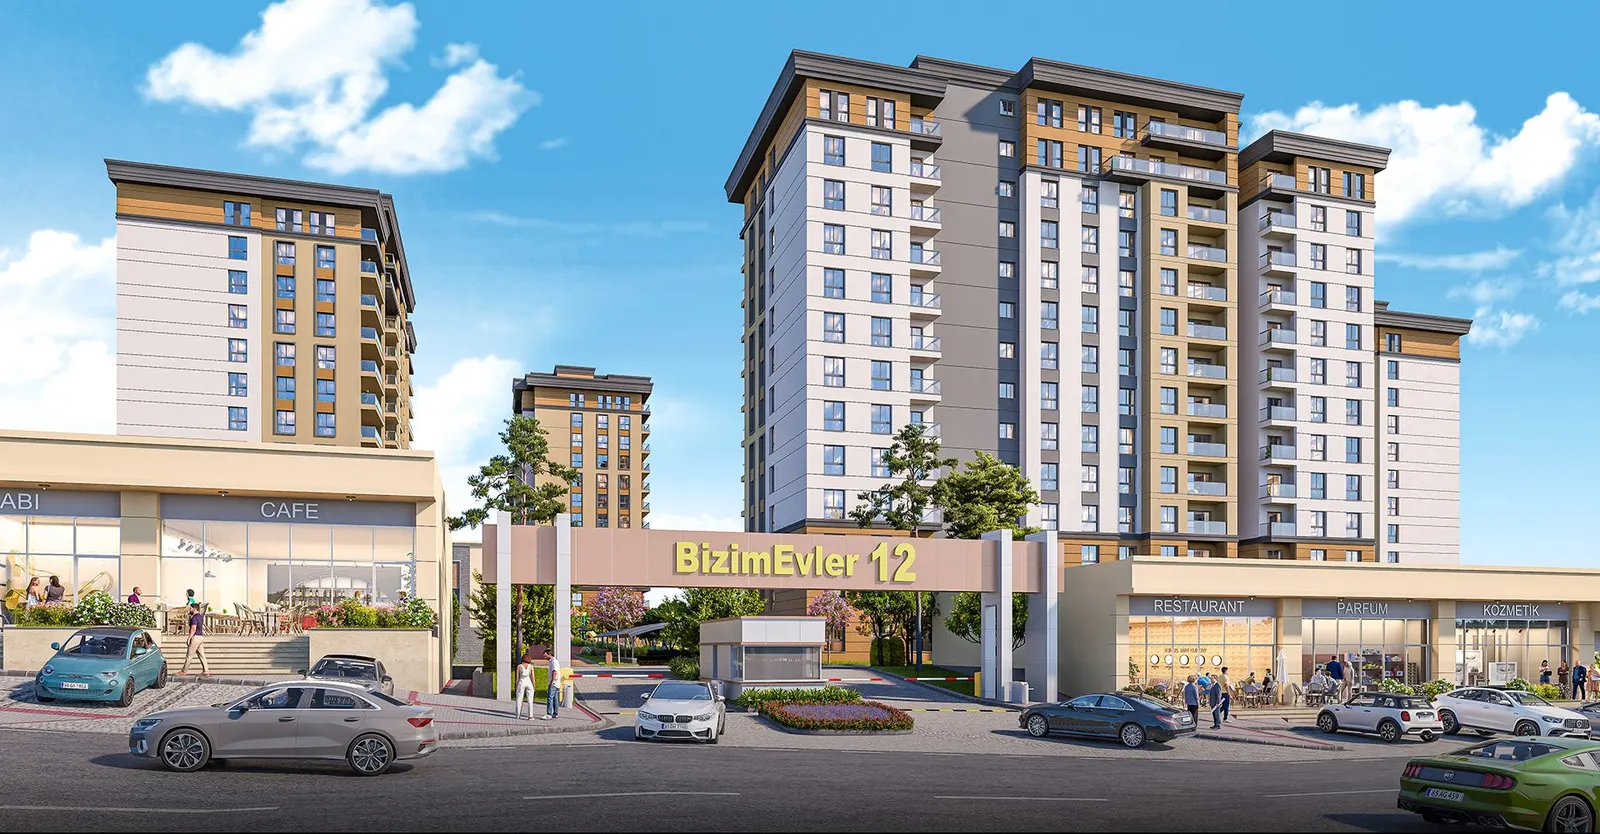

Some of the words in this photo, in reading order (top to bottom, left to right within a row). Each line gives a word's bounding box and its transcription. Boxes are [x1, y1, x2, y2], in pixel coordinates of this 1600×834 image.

[0, 492, 39, 510] ABI
[260, 501, 319, 519] CAFE
[674, 541, 859, 576] BizimEvler
[869, 541, 917, 583] 12
[1154, 599, 1245, 613] RESTAURANT
[1337, 601, 1388, 615] PARFÜM
